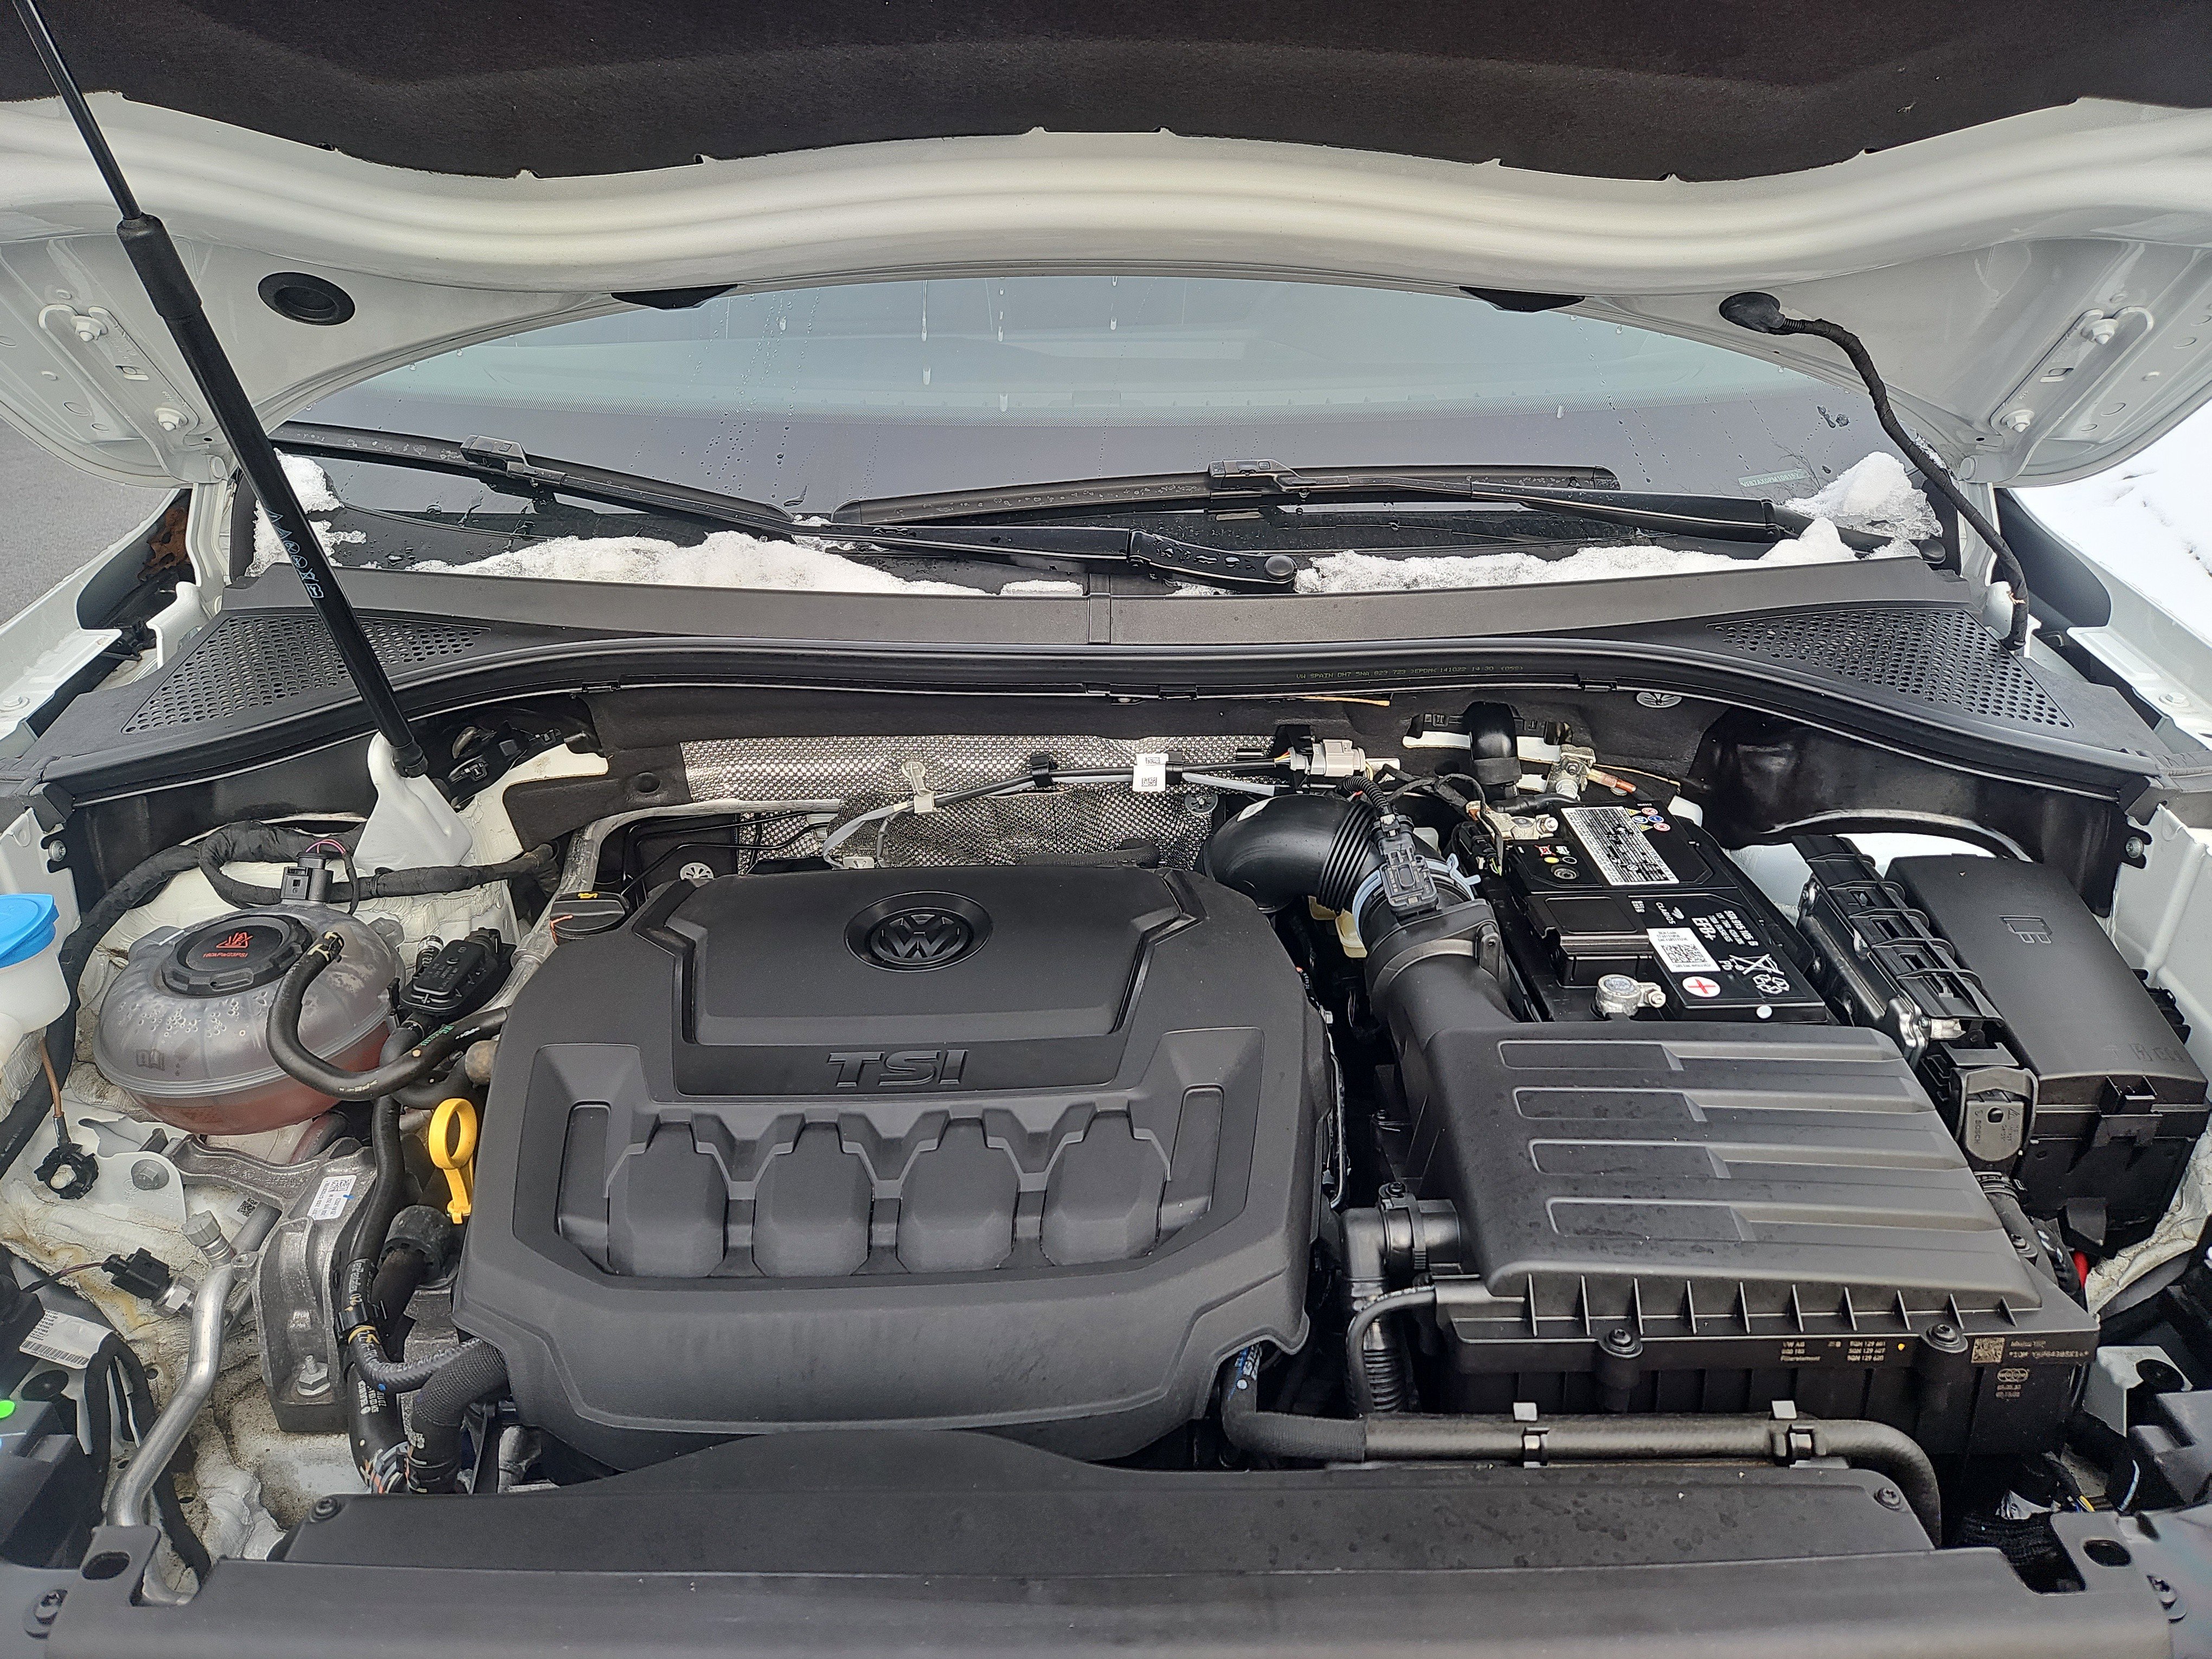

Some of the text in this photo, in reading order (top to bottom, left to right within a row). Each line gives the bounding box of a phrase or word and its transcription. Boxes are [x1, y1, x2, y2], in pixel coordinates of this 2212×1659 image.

[1655, 902, 1676, 925] CLARIOS
[1691, 917, 1716, 941] EFB+
[1731, 919, 1746, 930] 915
[1739, 930, 1754, 941] 105
[1718, 960, 1734, 971] Pb
[827, 1049, 969, 1087] TSI
